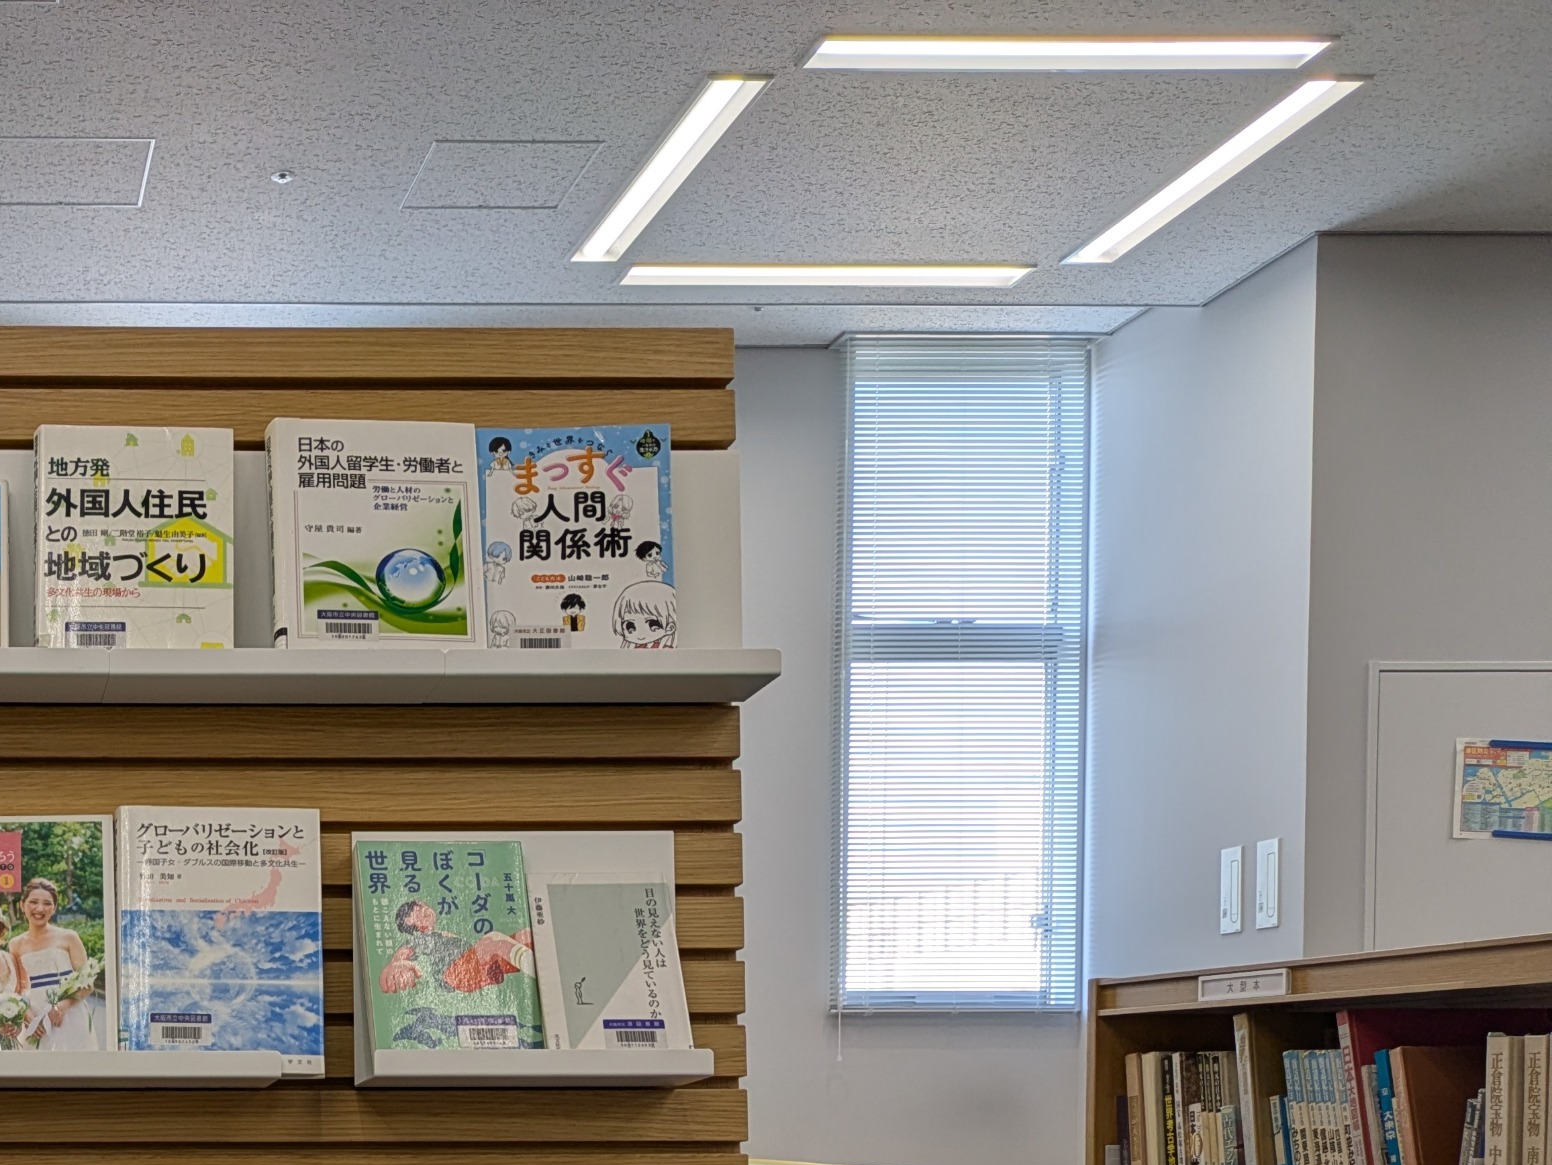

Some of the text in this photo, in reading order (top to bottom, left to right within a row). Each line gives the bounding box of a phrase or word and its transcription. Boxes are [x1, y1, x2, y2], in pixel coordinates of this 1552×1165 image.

[298, 436, 345, 453] 日本の
[48, 457, 111, 477] 地方発
[297, 455, 464, 475] 外国人留学生・労働者と
[514, 446, 633, 495] まっすぐ
[298, 472, 366, 489] 雇用問題
[372, 485, 421, 494] 労働と人材の
[45, 487, 208, 520] 外国人住民
[372, 494, 454, 504] グローバリゼーションと
[373, 502, 408, 512] 企業経営
[533, 490, 607, 523] 人間
[45, 525, 78, 543] との
[304, 524, 344, 533] 守屋 貴司
[518, 526, 632, 561] 関係術
[44, 550, 207, 583] 地域づくり
[47, 586, 141, 598] 多文化共生の現場から
[320, 610, 376, 619] 大阪市立中央図書館
[137, 822, 305, 839] グローバリゼーションと
[137, 840, 259, 856] 子どもの社会化
[365, 850, 391, 895] 世界
[400, 850, 422, 893] 見る
[433, 850, 460, 916] ぼくが
[466, 849, 494, 935] 「コーダ」の
[502, 872, 516, 903] 五十嵐
[644, 887, 667, 968] 目の見えない人は
[633, 907, 662, 1019] 世界をどう見ているのか
[1226, 978, 1261, 994] 大型本
[154, 1014, 209, 1022] 大阪市立中央図書館
[1489, 1052, 1504, 1137] 正倉院宝物
[1527, 1051, 1542, 1138] 正倉院宝物
